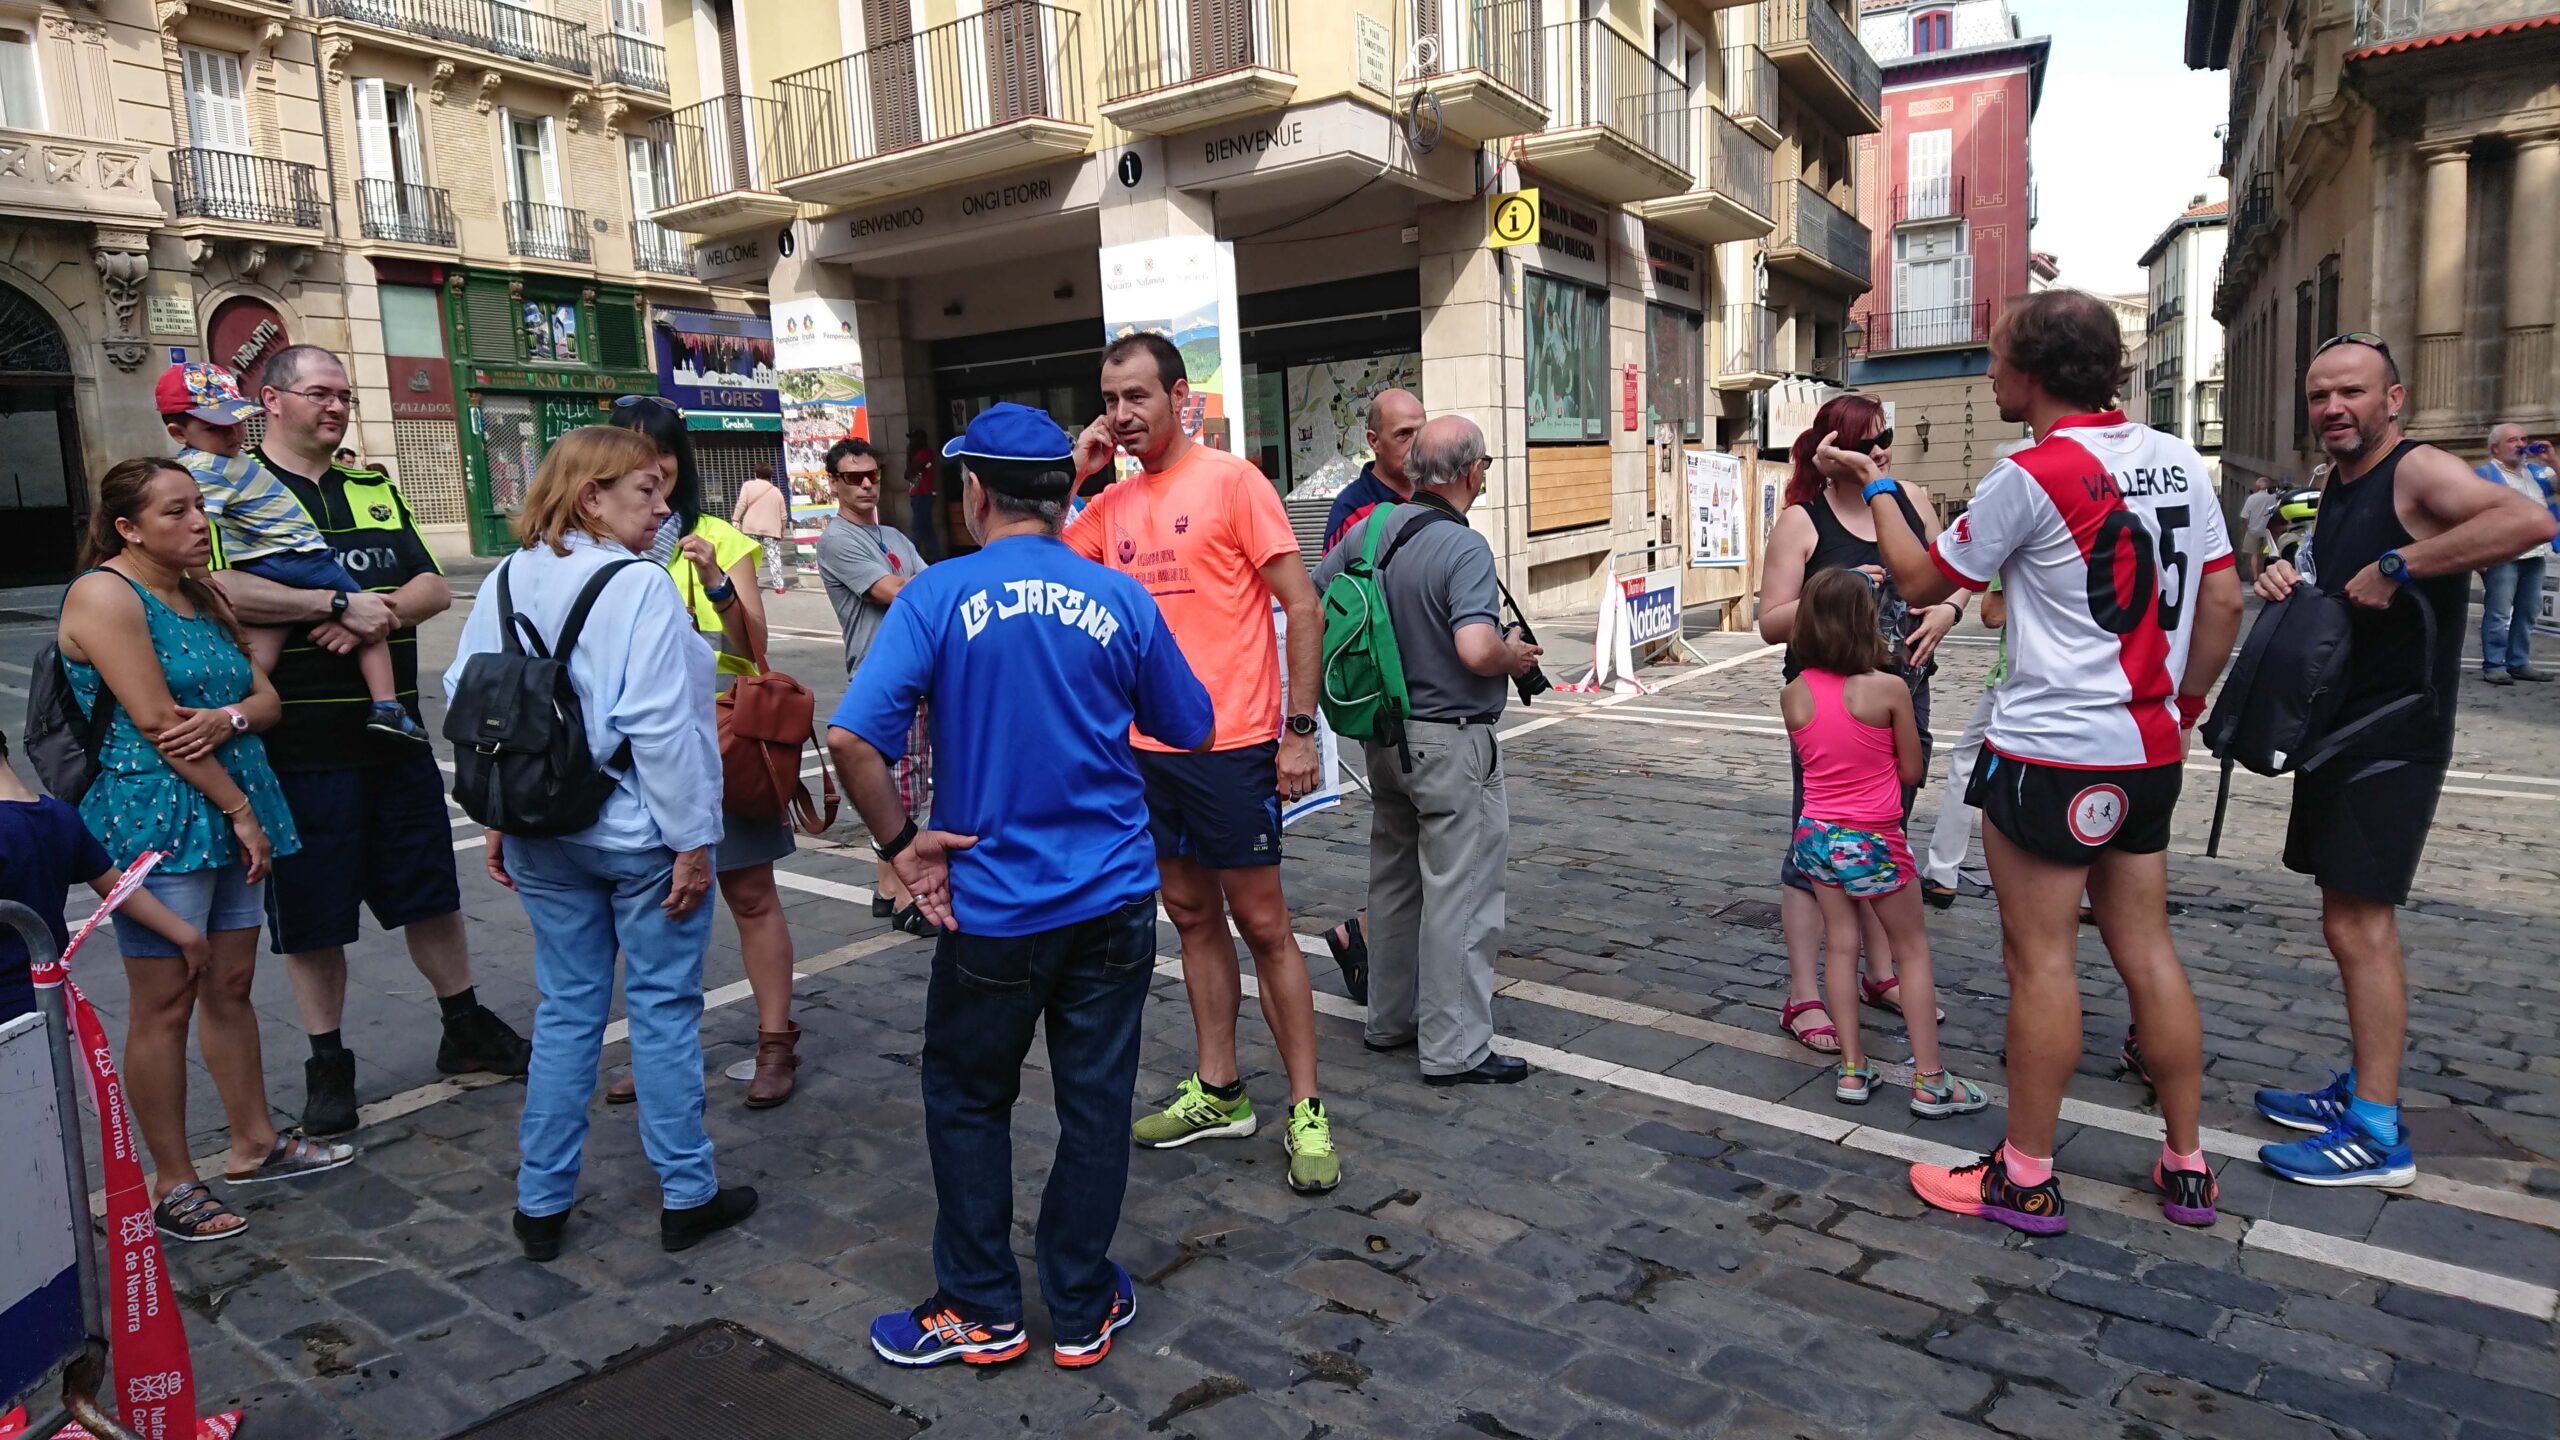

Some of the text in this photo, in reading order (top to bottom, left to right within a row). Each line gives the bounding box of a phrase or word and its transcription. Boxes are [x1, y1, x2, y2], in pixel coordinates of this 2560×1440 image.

[1205, 122, 1302, 164] BIENVENUE
[962, 179, 1053, 216] ONGI ETORRI
[850, 207, 924, 239] BIENVENIDO
[704, 242, 760, 268] WELCOME
[231, 319, 279, 369] INFANTIL
[535, 373, 561, 389] KM
[700, 389, 764, 408] FLORES
[392, 402, 451, 413] CALZADOS
[546, 396, 594, 419] KOLDO
[1962, 385, 1975, 494] FARMACIA
[2081, 465, 2188, 501] VALLEKAS
[2087, 504, 2190, 634] 05
[960, 579, 1119, 648] LA JARANA
[1627, 593, 1672, 641] Noticias
[108, 1082, 126, 1160] Gobernua
[124, 1251, 142, 1333] de Navarra
[142, 1245, 159, 1317] Gobierno
